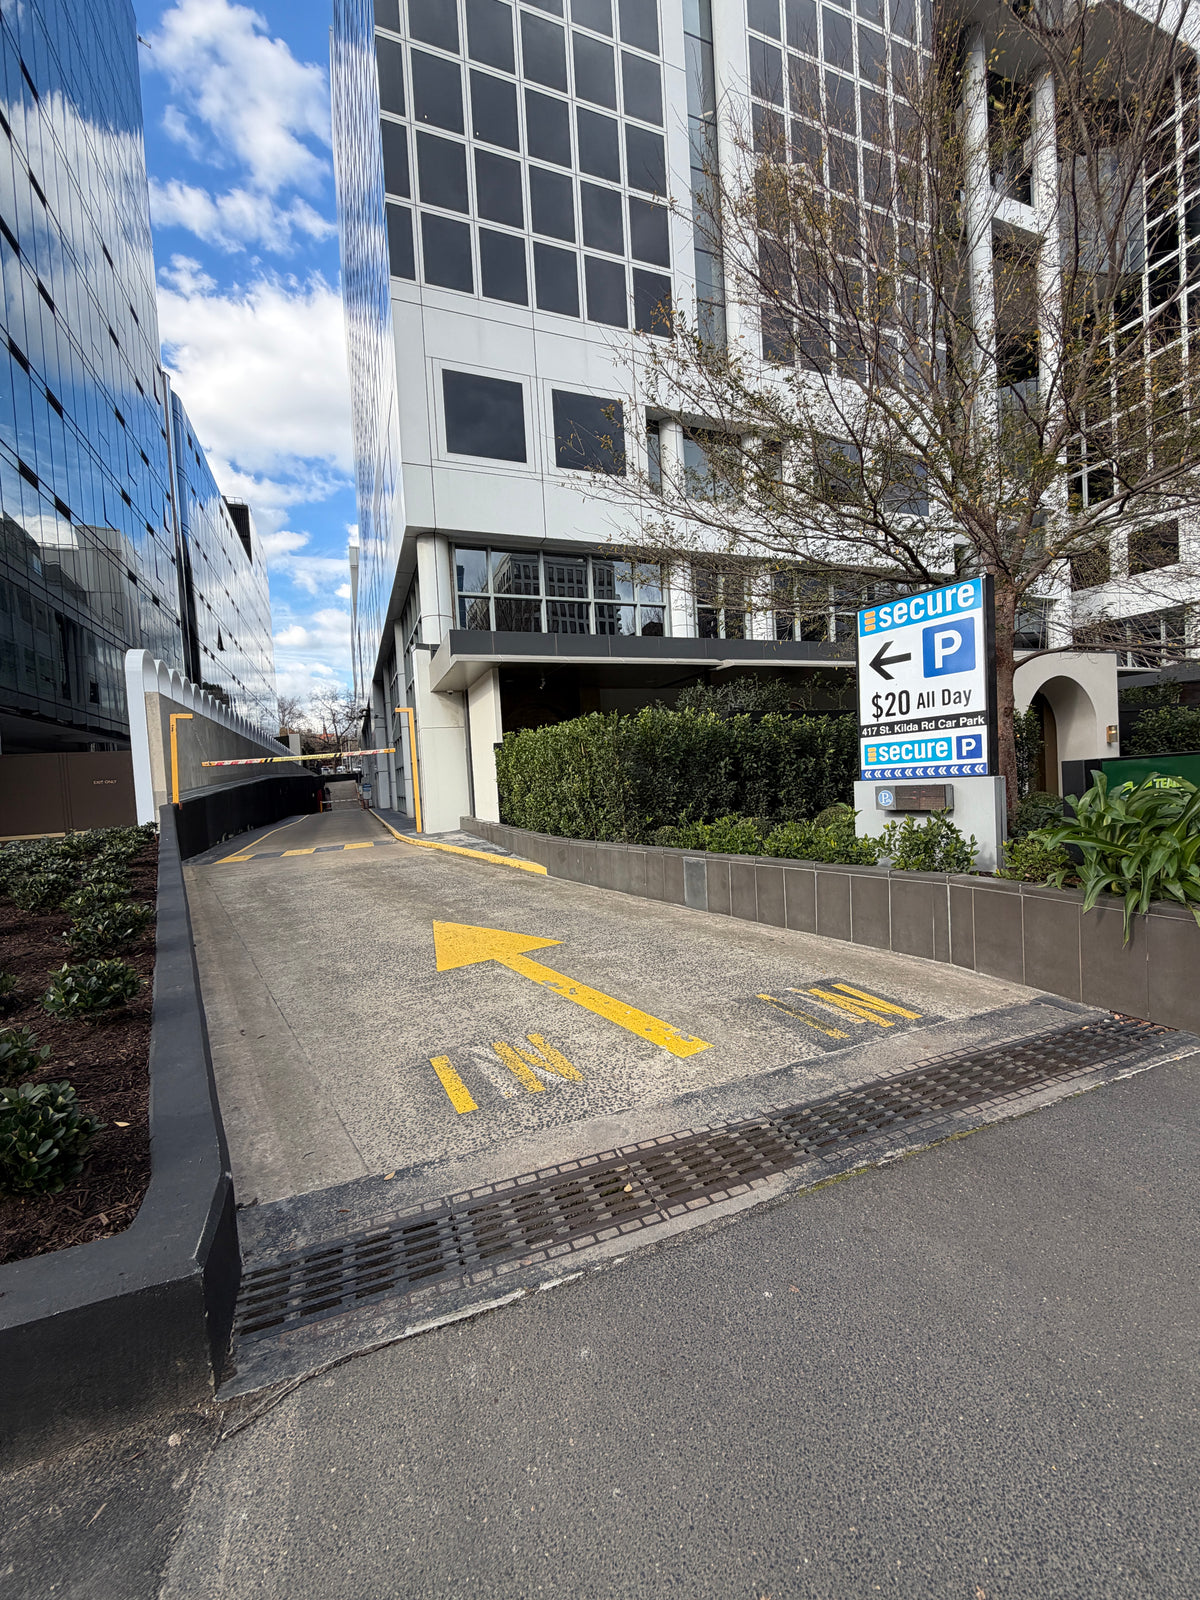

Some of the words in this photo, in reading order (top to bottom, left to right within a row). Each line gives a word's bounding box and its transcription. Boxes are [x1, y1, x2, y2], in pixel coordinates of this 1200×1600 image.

[878, 583, 975, 628] secure
[934, 629, 963, 669] P
[871, 690, 911, 722] $20
[916, 691, 935, 710] All
[941, 688, 972, 708] Day
[861, 726, 878, 737] 417
[879, 725, 892, 735] St.
[894, 722, 919, 734] Kilda
[921, 719, 935, 731] Rd
[937, 717, 957, 729] Car
[959, 714, 985, 727] Park
[878, 740, 949, 762] secure
[961, 738, 977, 757] P
